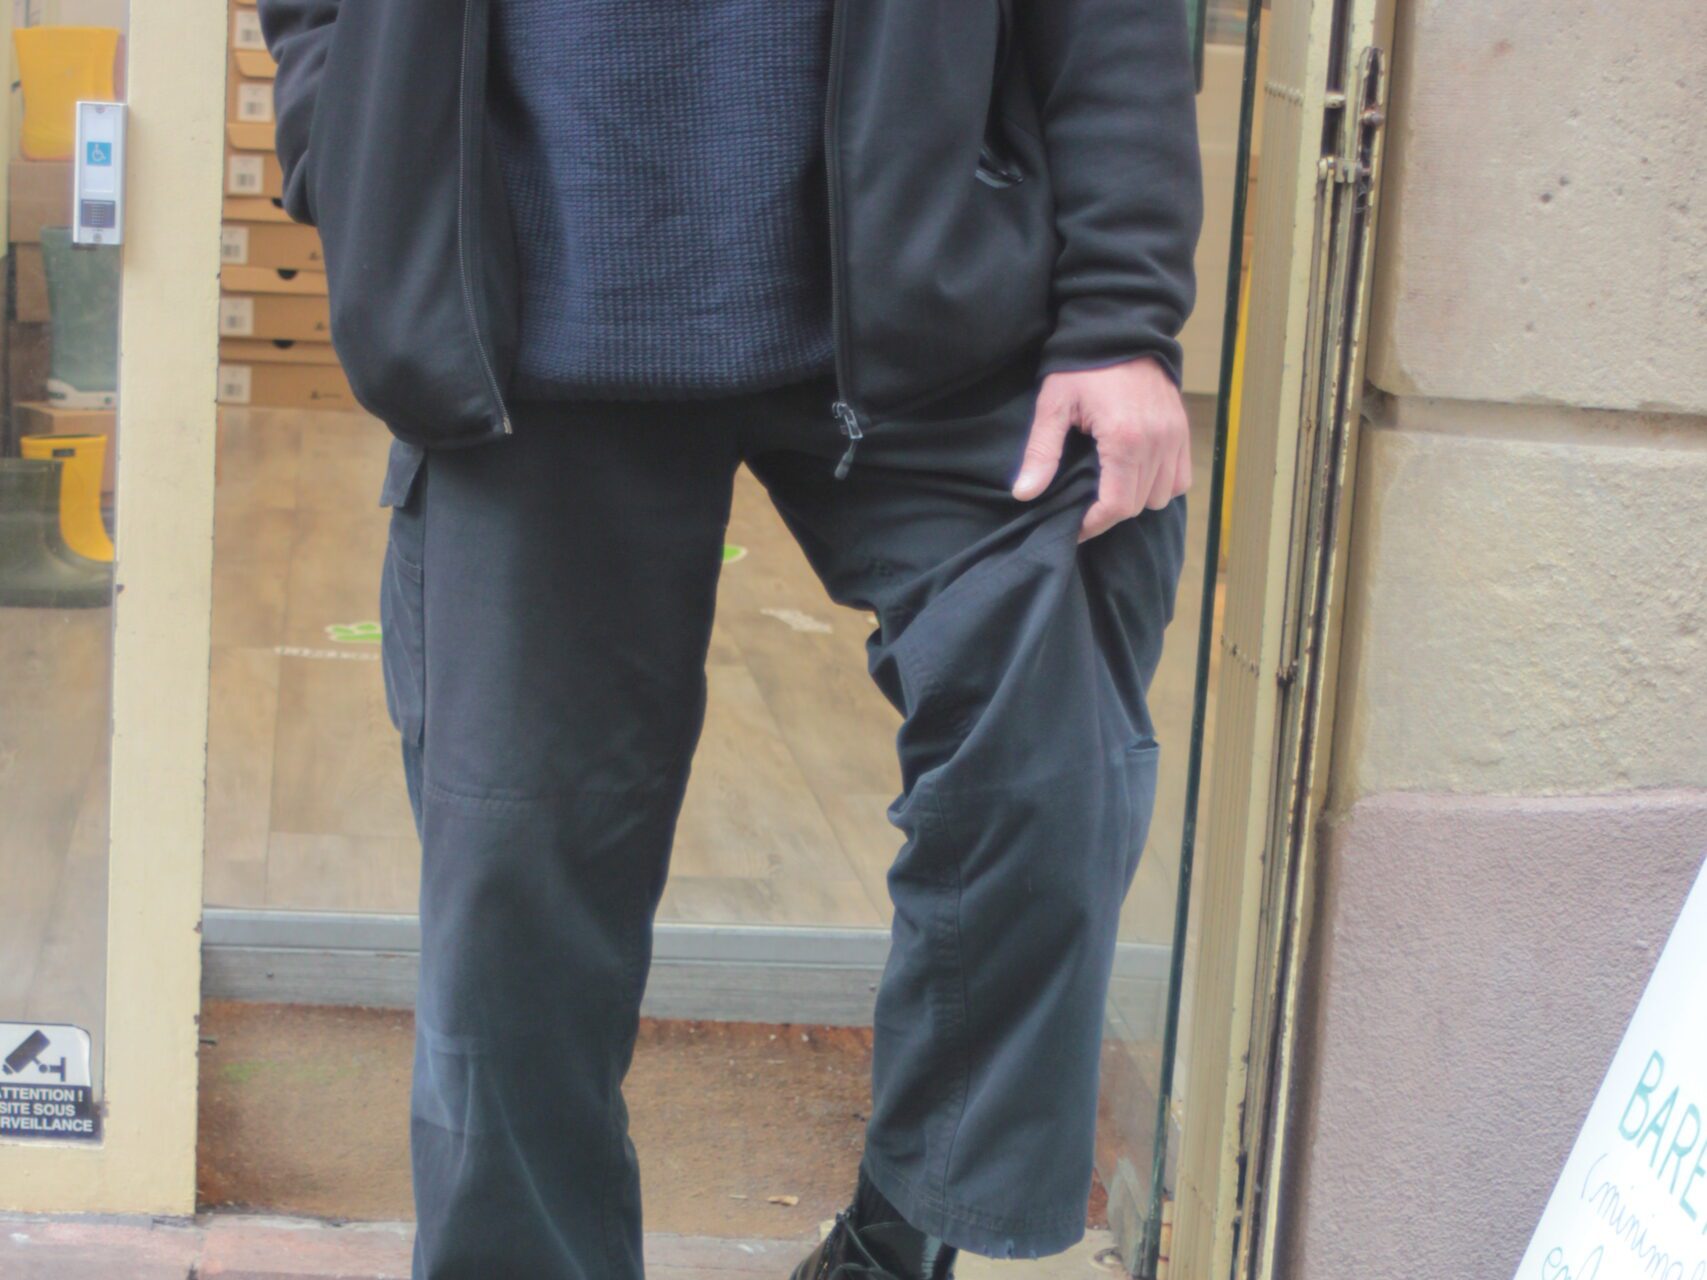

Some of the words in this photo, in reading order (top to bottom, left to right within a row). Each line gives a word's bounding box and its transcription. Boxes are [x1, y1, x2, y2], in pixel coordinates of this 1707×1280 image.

[0, 1086, 75, 1101] TTENTION
[0, 1100, 31, 1115] SITE
[33, 1102, 76, 1117] SOUS
[1618, 1049, 1707, 1236] BARE
